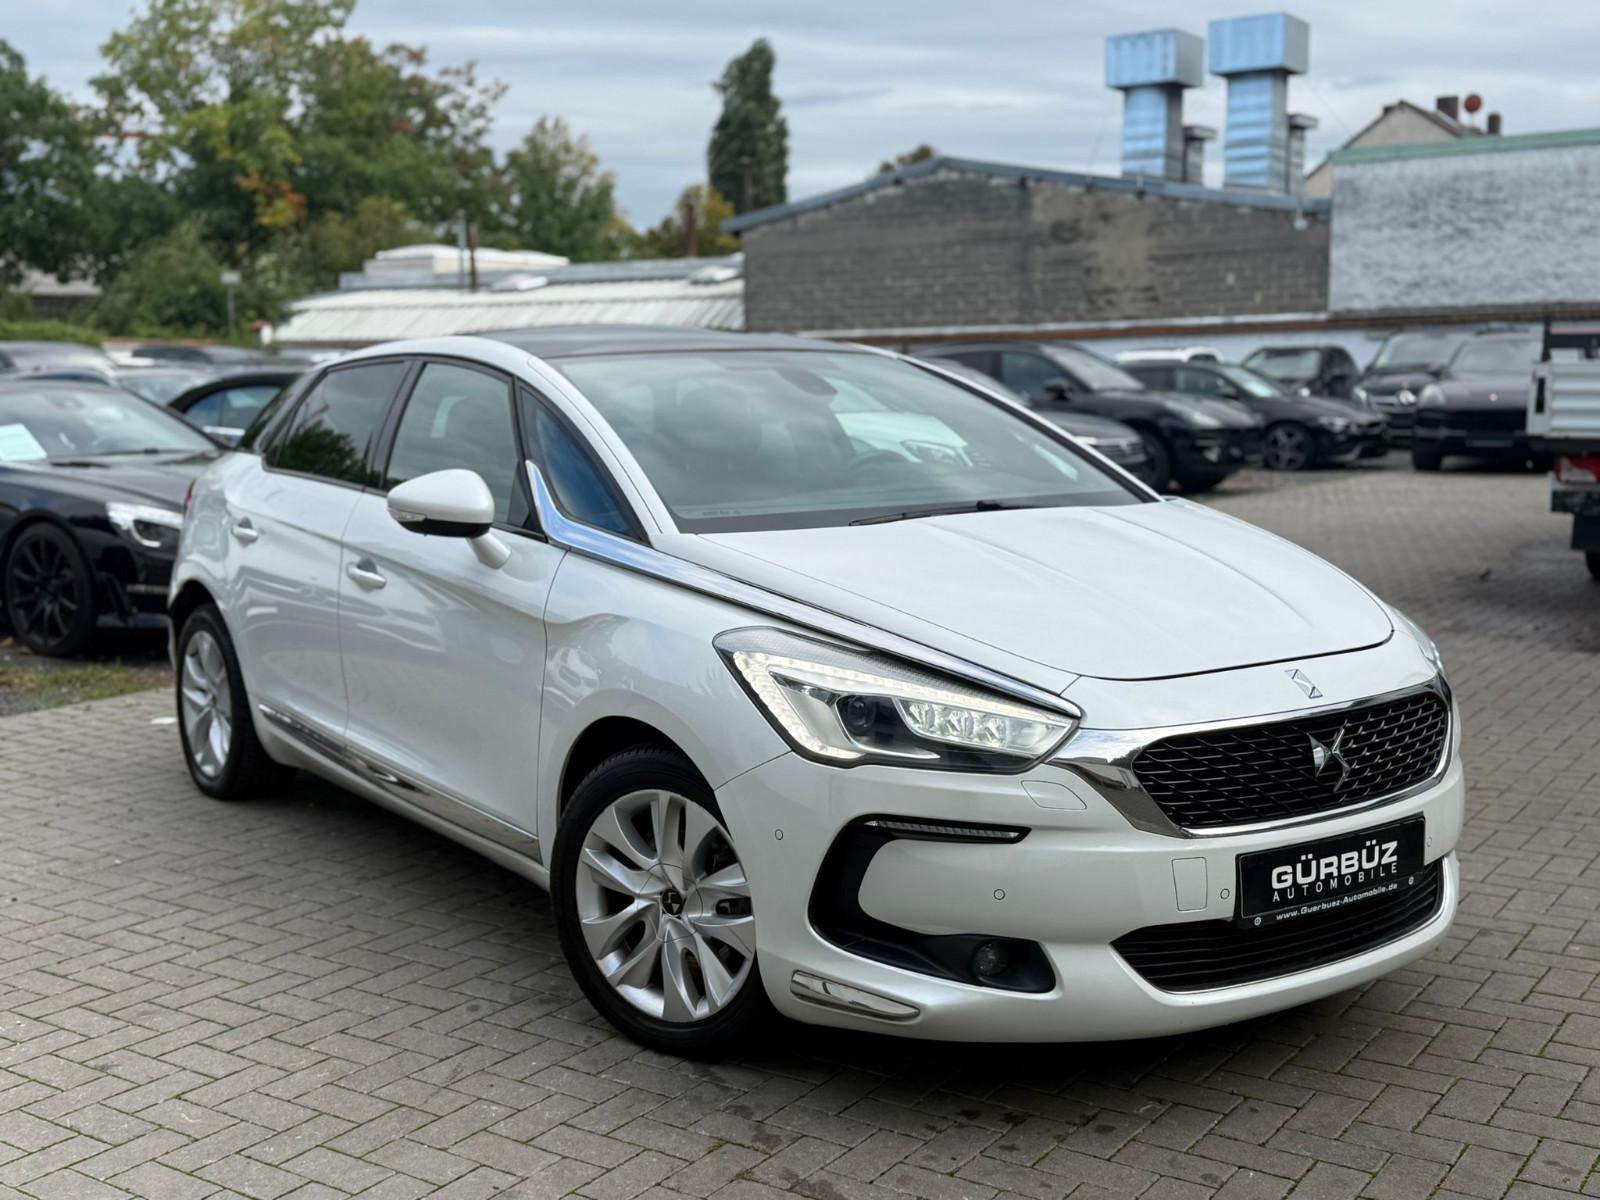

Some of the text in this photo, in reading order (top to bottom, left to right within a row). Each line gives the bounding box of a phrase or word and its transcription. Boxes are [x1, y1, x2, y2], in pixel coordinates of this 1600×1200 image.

[1271, 839, 1398, 890] GÜRBÜZ
[1272, 862, 1398, 902] AUTOMOBILE
[1276, 883, 1398, 920] www.Guerbuez-Automobile.de
